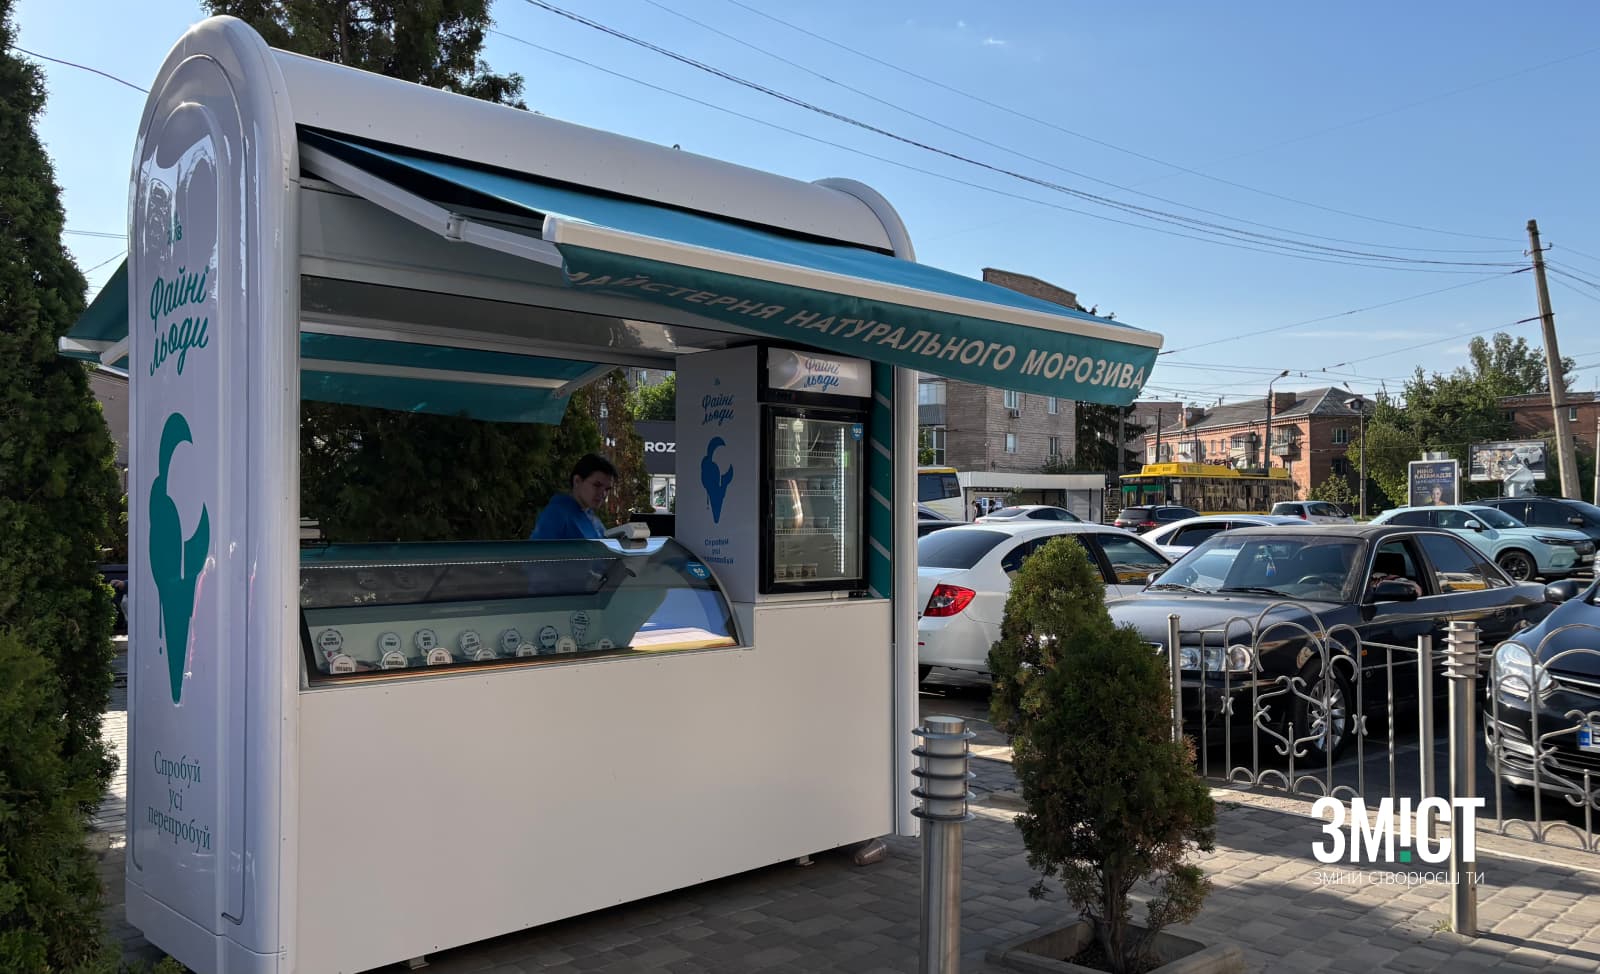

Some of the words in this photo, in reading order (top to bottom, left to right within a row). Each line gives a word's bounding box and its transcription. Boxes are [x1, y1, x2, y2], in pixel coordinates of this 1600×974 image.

[150, 265, 209, 332] Файні
[150, 317, 208, 376] льоди
[784, 310, 1016, 371] НАТУРАЛЬНОГО
[1020, 349, 1145, 390] МОРОЗИВА
[805, 359, 840, 377] Файні
[803, 374, 839, 392] льоди
[154, 750, 201, 788] Спробуй
[168, 788, 183, 813] усі
[148, 805, 211, 853] перепробуй
